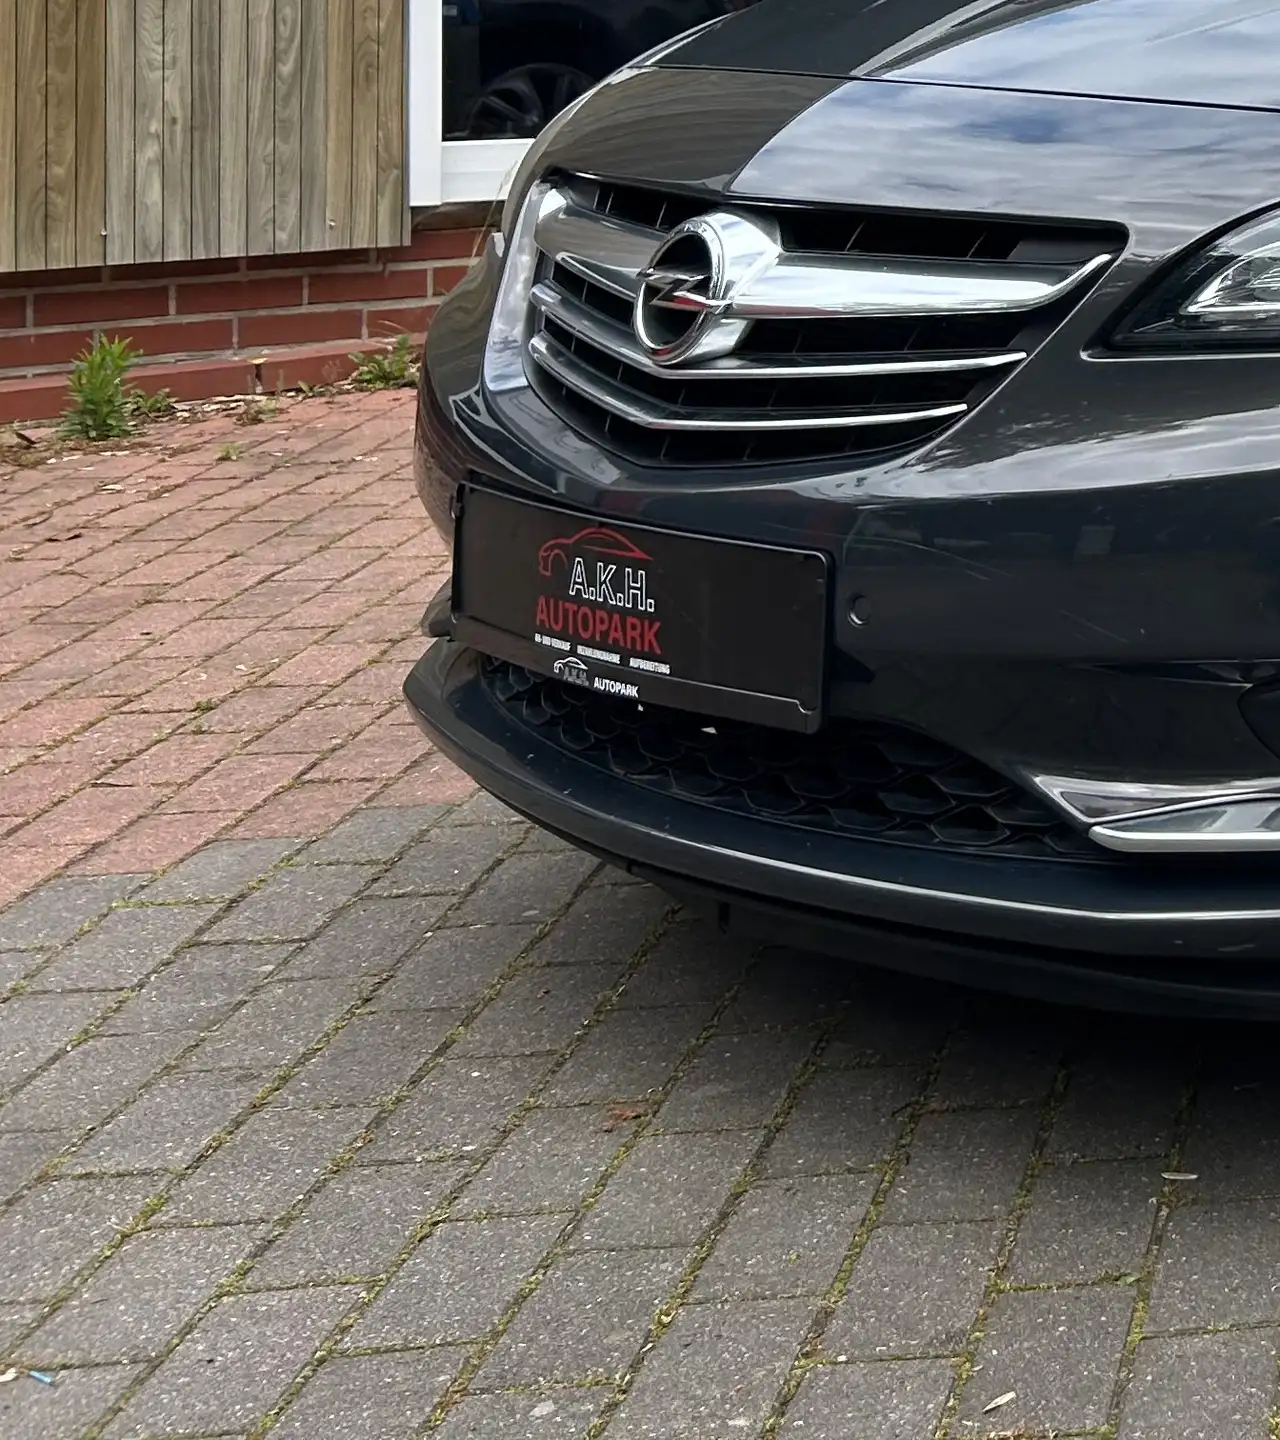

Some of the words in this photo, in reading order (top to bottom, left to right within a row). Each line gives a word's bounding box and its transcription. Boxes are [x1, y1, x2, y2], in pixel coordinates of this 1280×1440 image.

[569, 557, 655, 613] A.K.H.
[535, 594, 662, 655] AUTOPARK
[593, 676, 639, 699] AUTOPARK
